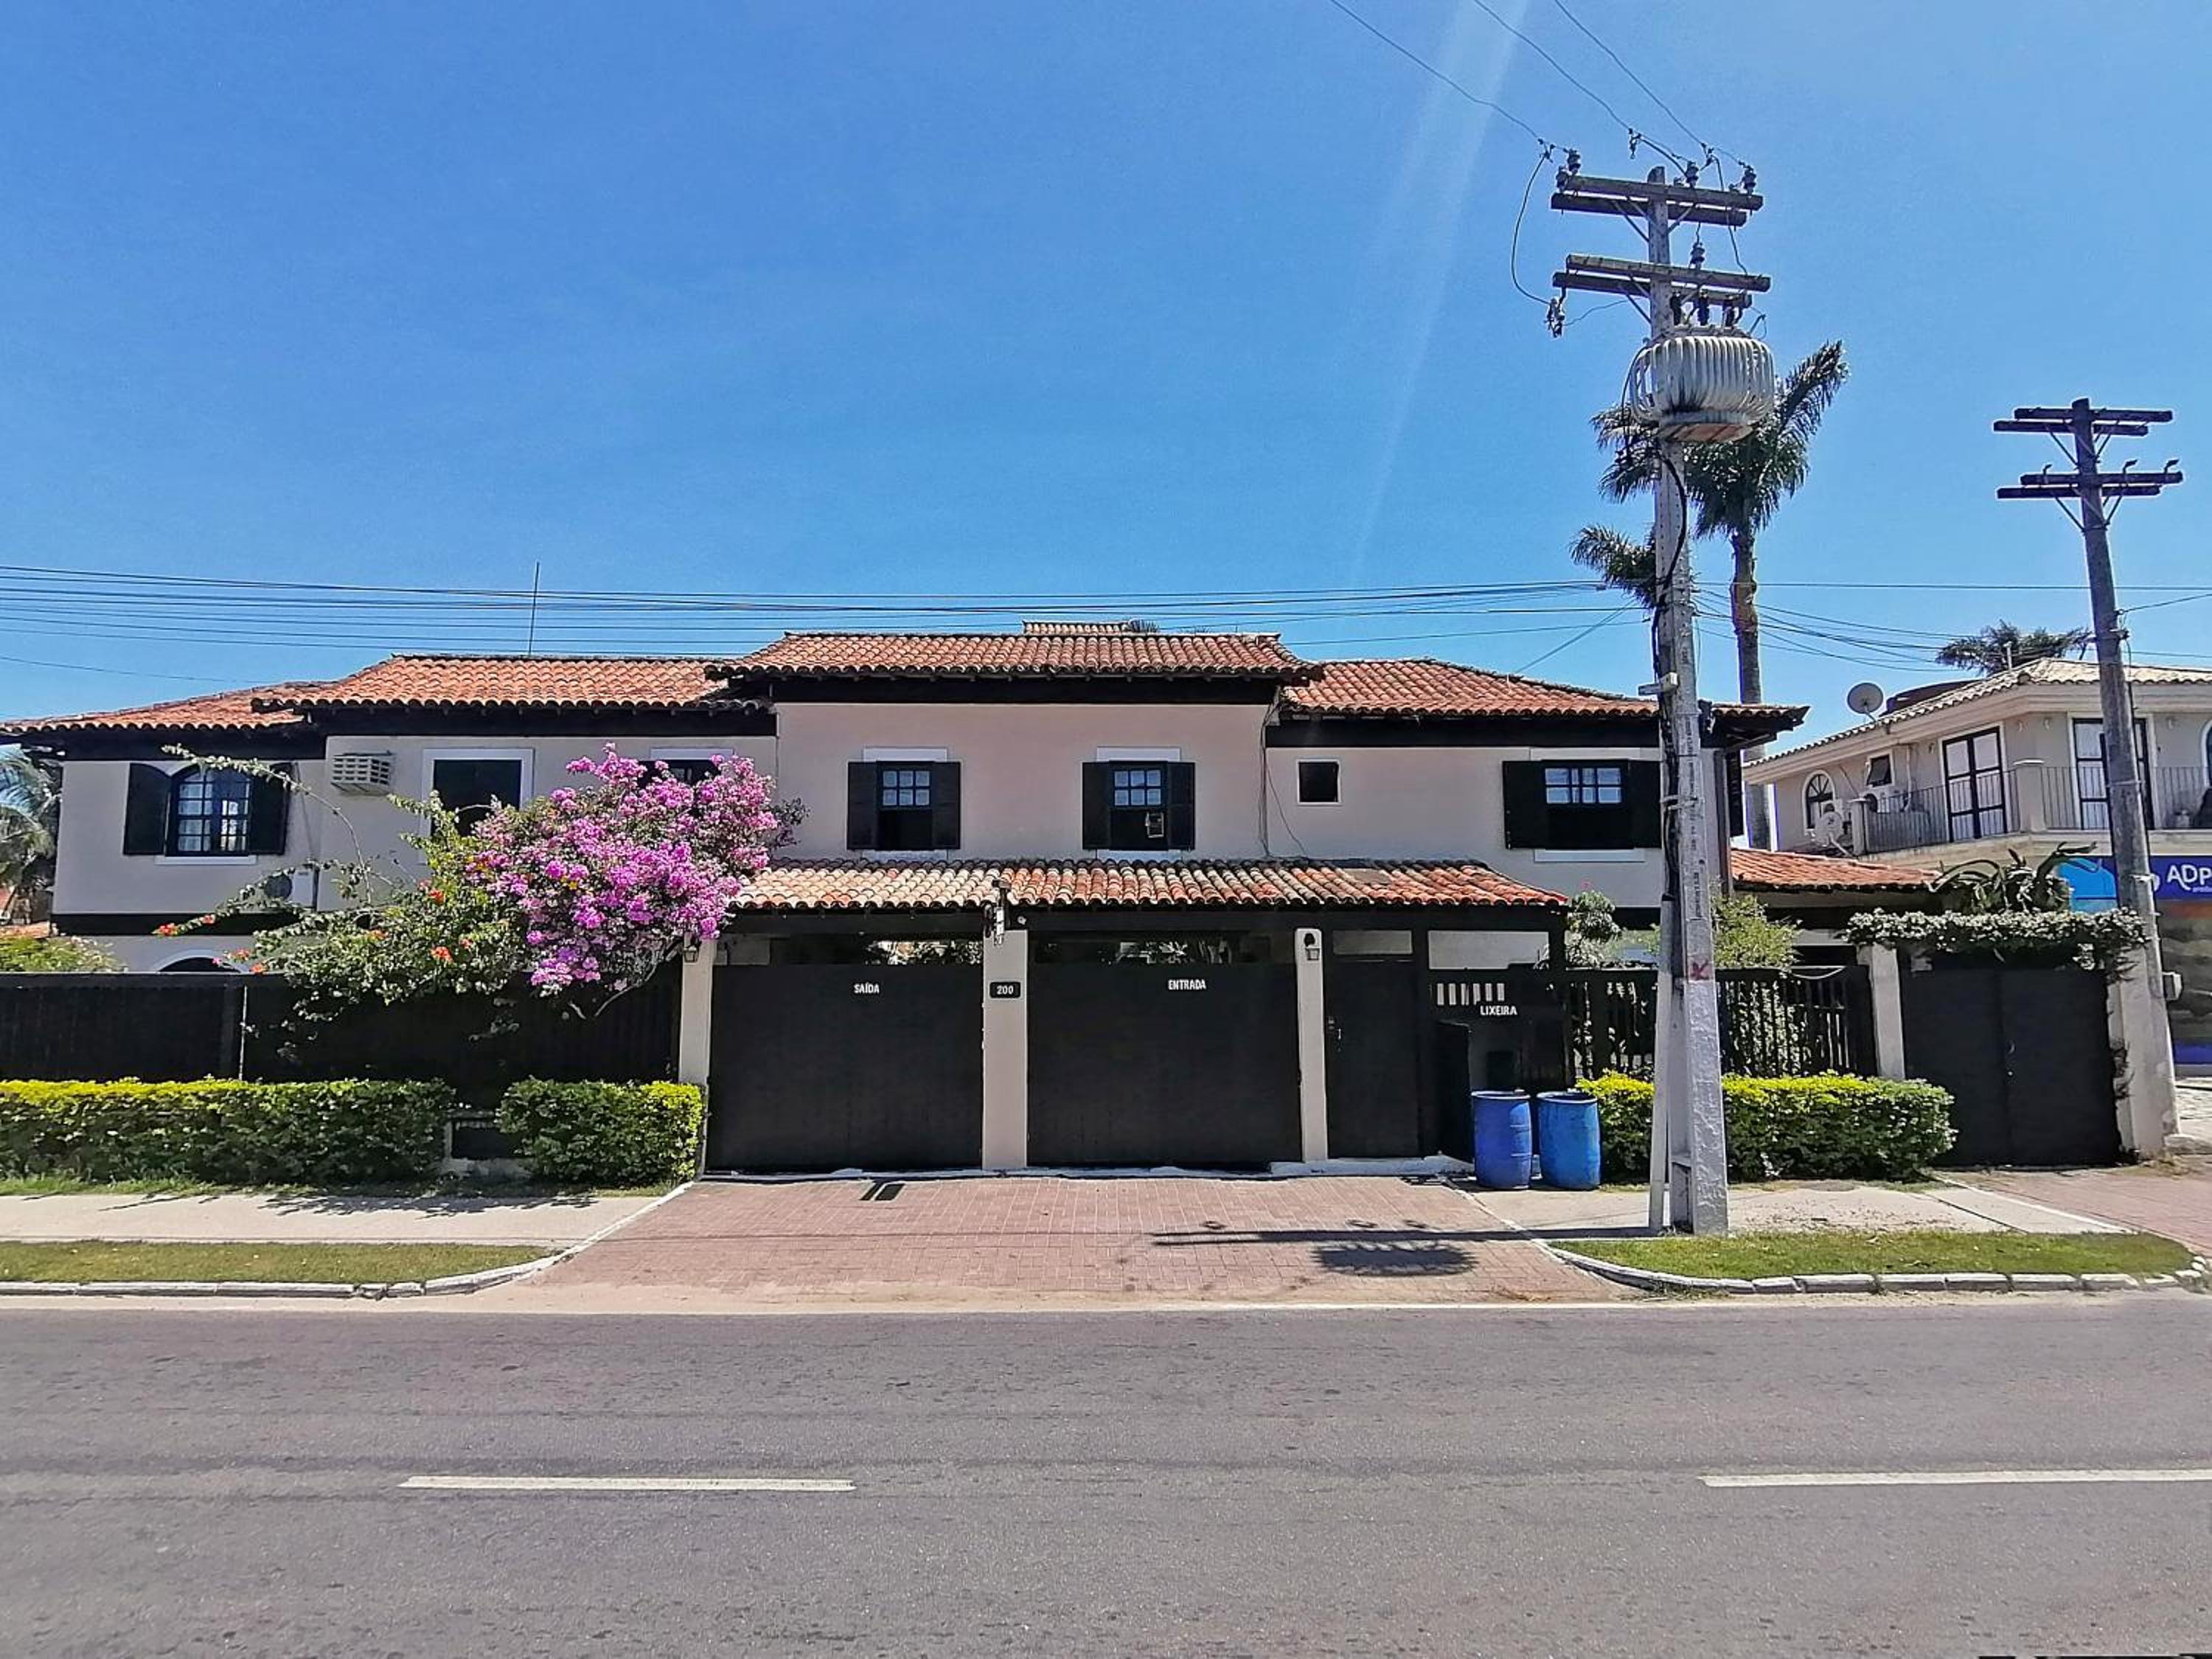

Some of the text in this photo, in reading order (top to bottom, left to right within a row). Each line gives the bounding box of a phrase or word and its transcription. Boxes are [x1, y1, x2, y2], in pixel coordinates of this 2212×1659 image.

[854, 981, 880, 993] SAÍDA
[1168, 979, 1206, 990] ENTRADA
[997, 985, 1014, 995] 200
[1480, 1006, 1517, 1015] LIXEIRA
